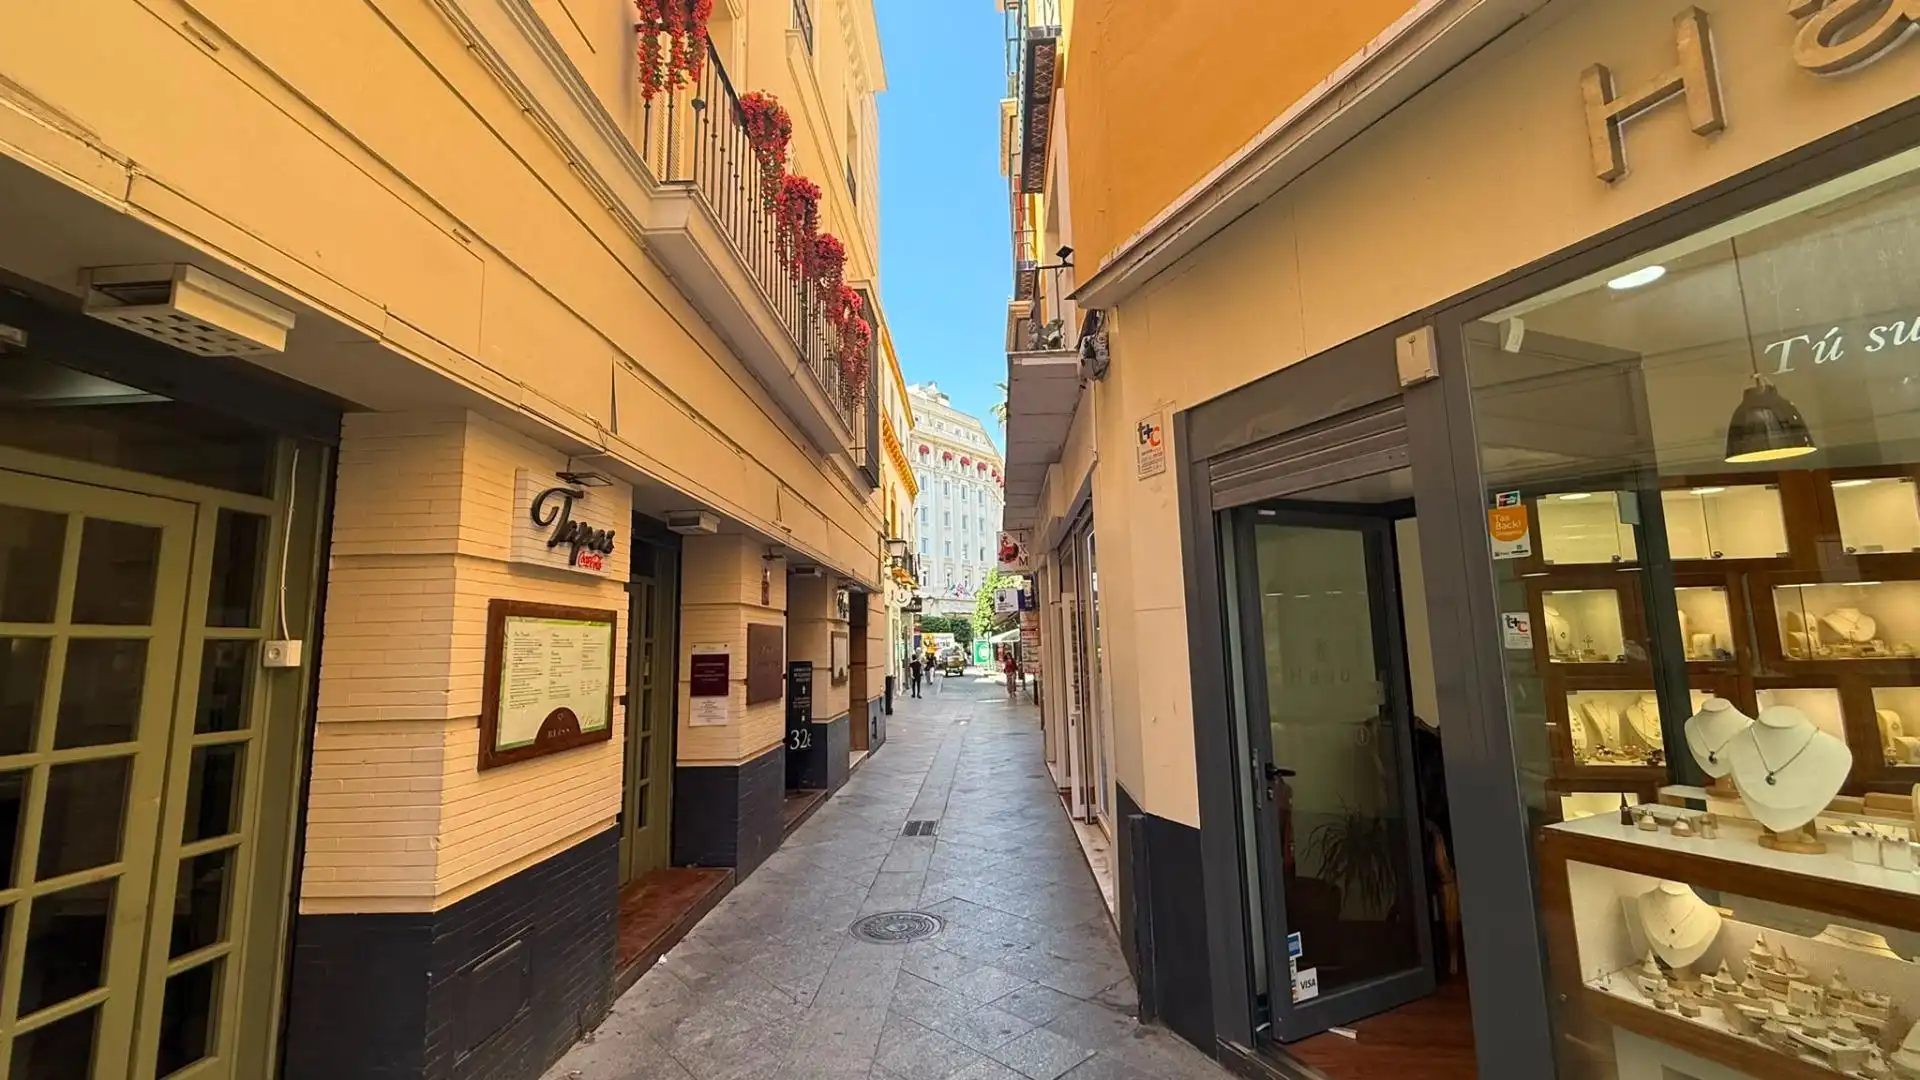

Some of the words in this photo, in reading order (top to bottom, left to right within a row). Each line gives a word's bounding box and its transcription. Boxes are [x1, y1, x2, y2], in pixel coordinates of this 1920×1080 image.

[1764, 326, 1844, 375] Tú
[530, 487, 615, 566] Tapas
[1492, 514, 1510, 523] Tax
[1495, 519, 1522, 530] Back!
[789, 728, 812, 750] 32€
[1300, 978, 1316, 990] VISA
